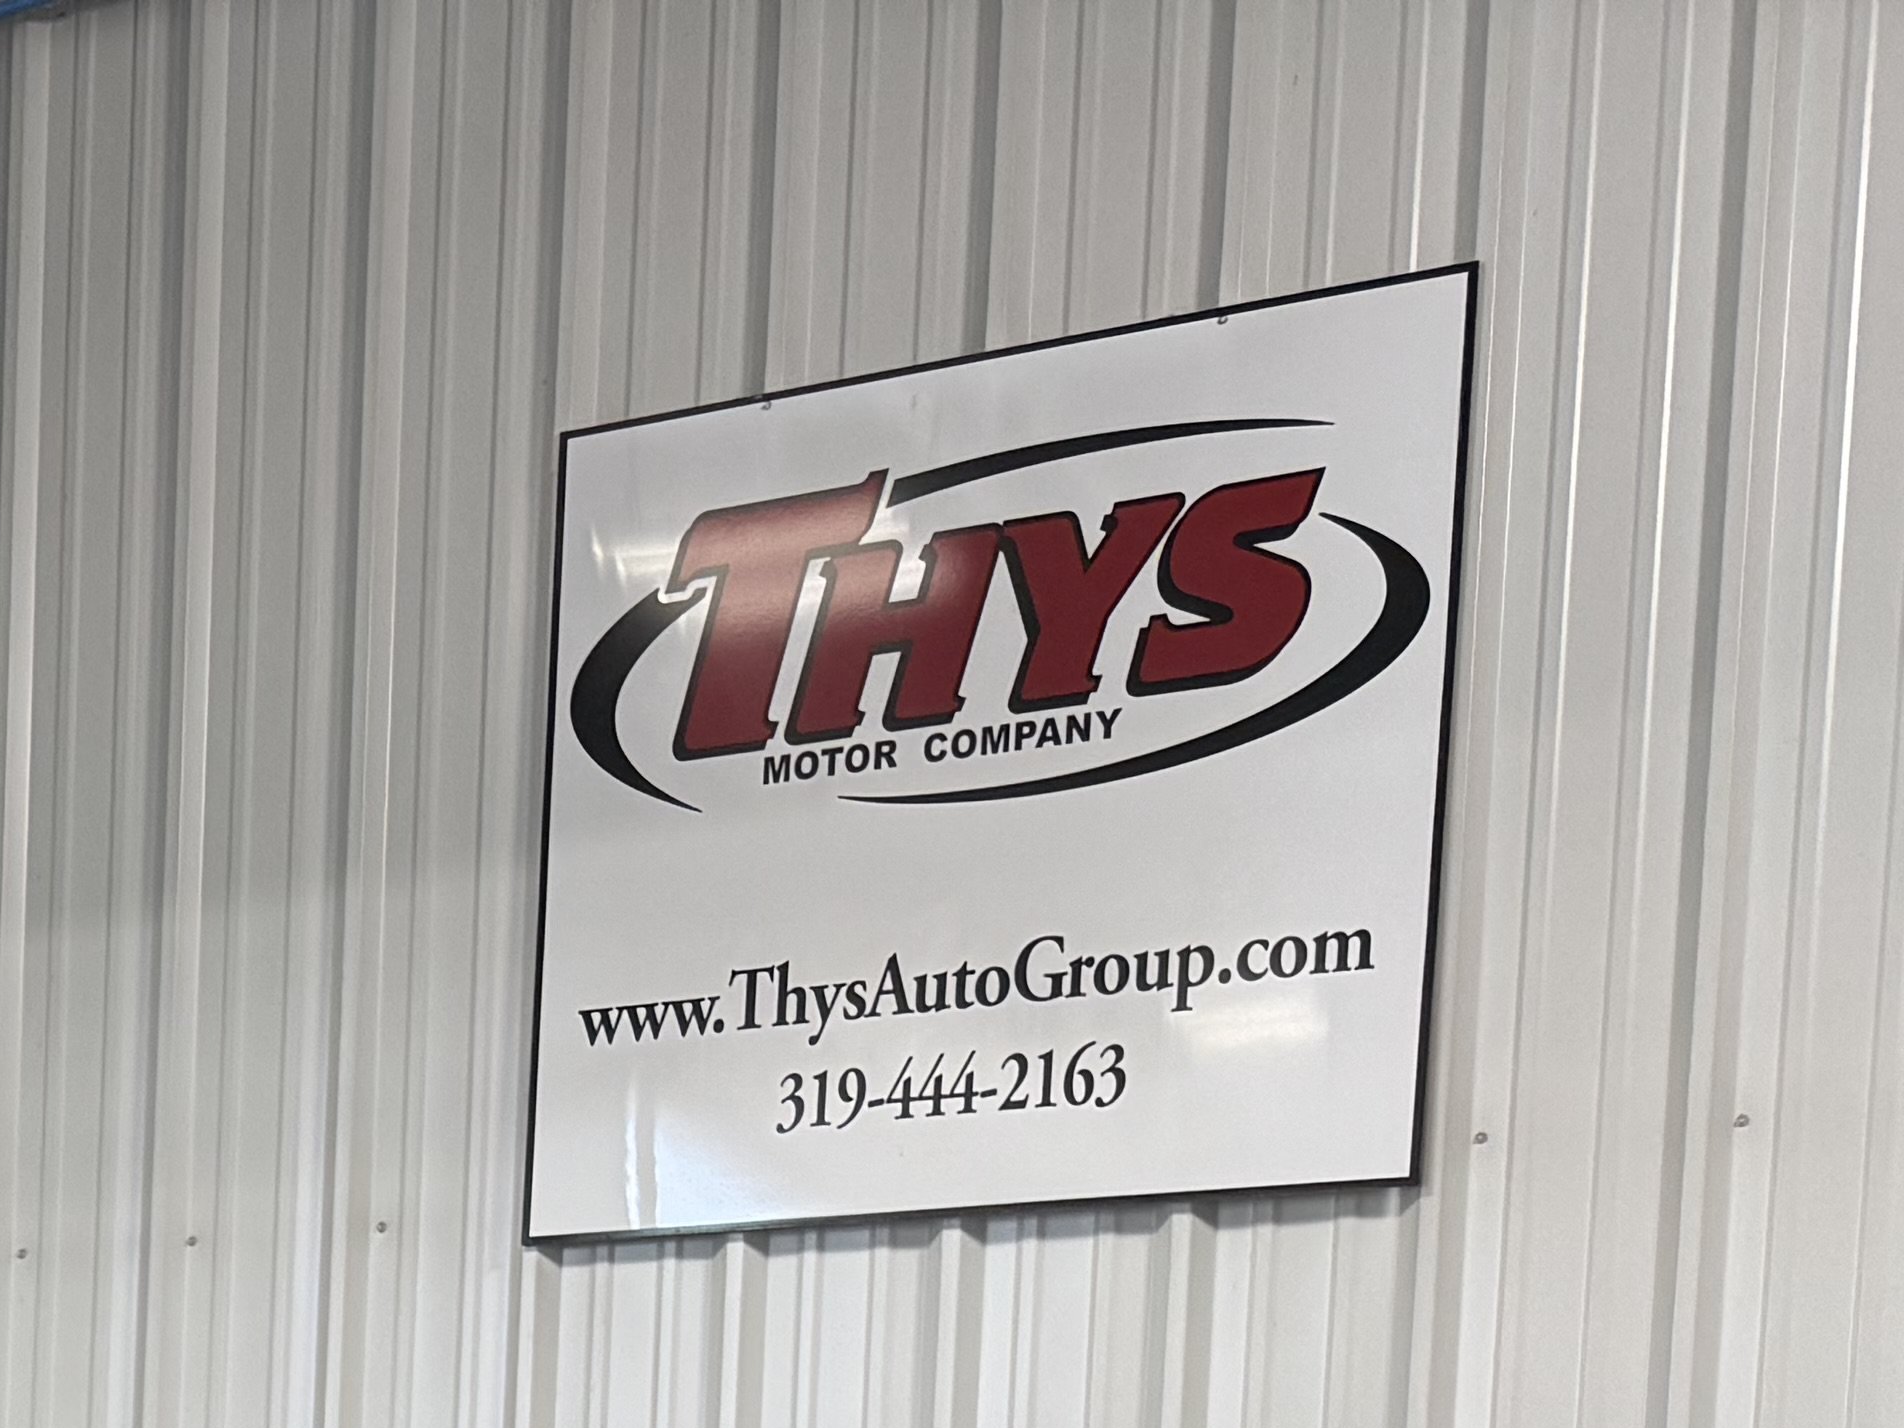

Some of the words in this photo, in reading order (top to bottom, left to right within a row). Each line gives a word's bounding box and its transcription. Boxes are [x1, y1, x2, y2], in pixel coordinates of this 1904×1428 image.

[667, 466, 1326, 761] THYS
[762, 738, 899, 785] MOTOR
[923, 707, 1123, 763] COMPANY
[579, 927, 1375, 1046] www.ThysAutoGroup.com
[775, 1041, 1128, 1135] 319-444-2163
